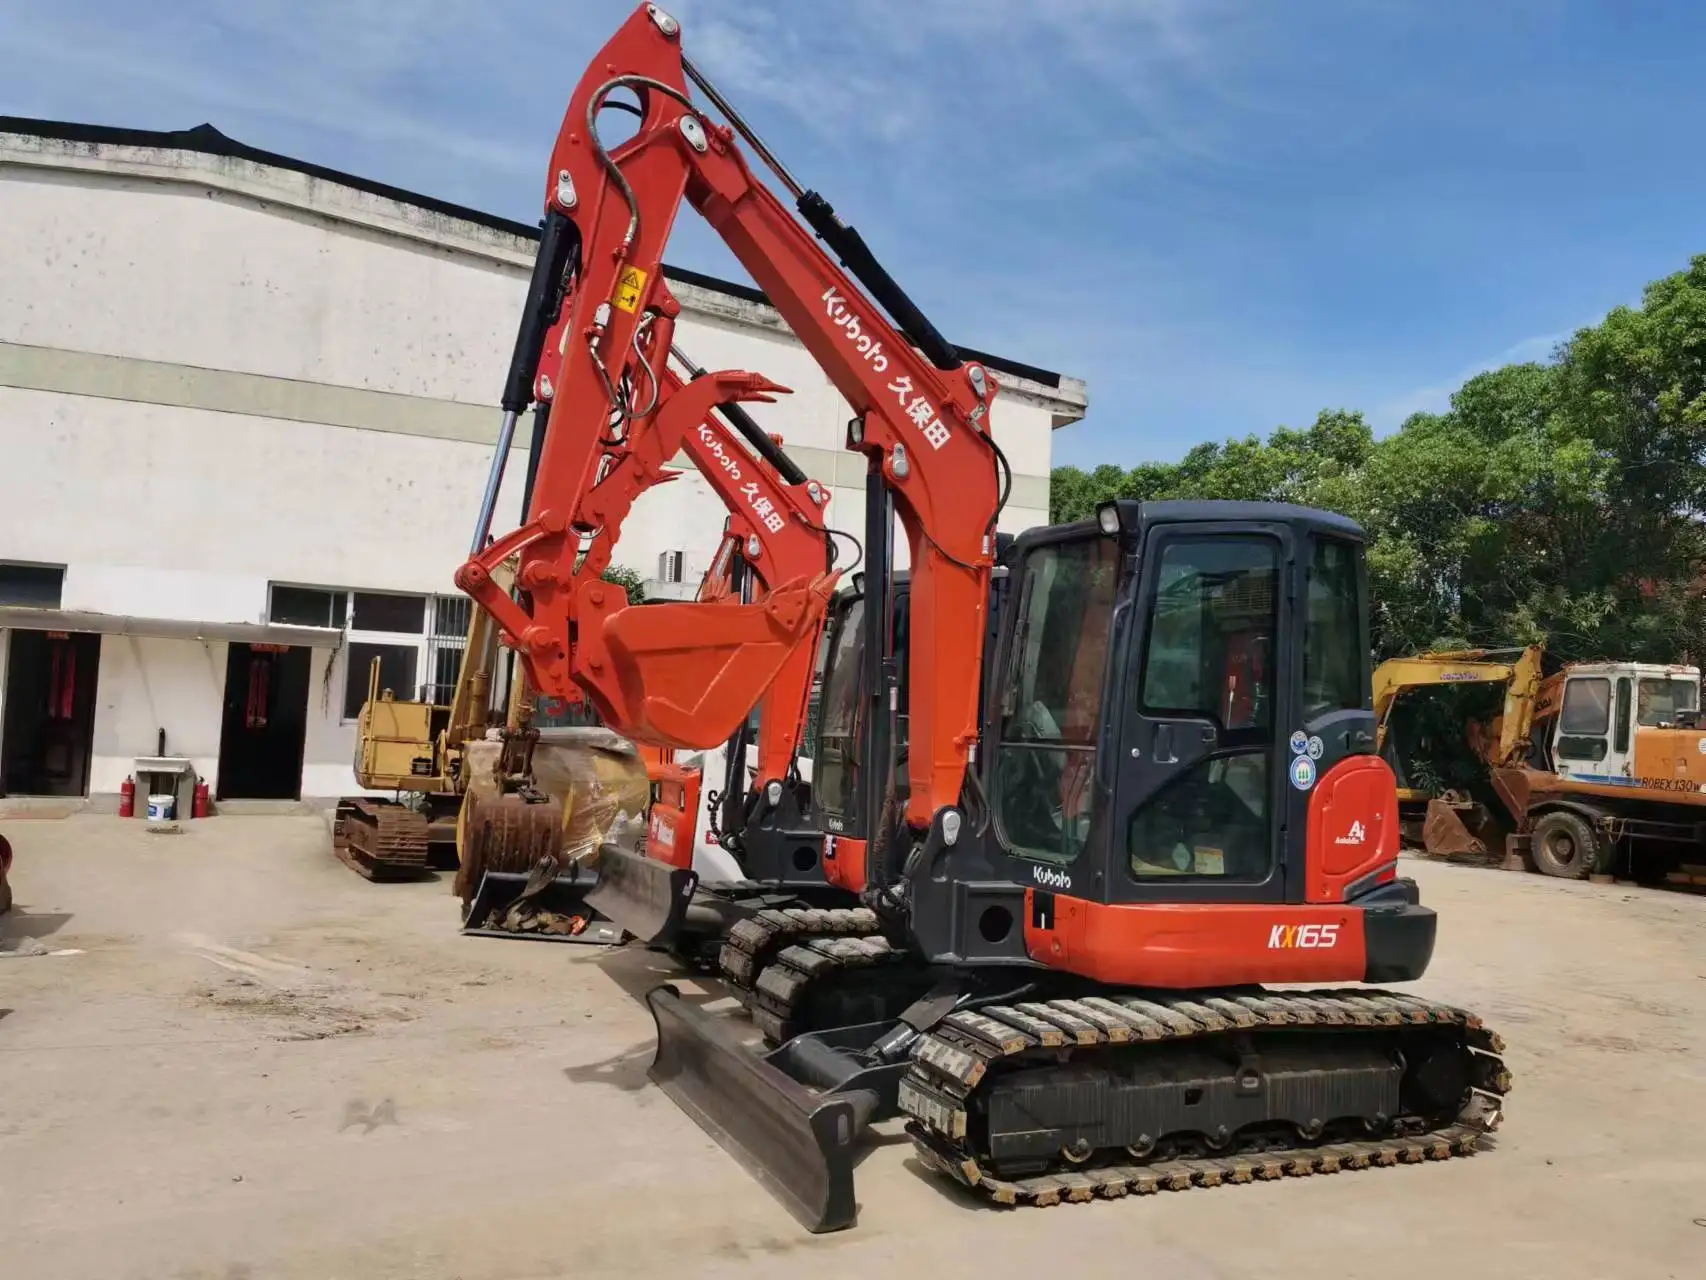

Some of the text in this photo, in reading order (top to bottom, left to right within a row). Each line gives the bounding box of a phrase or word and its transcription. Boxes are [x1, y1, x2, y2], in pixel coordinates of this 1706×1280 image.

[822, 286, 951, 451] Kubota 久保田
[697, 423, 785, 534] Kubota 久保田
[1641, 776, 1673, 791] ROBEX
[1033, 865, 1072, 888] Kubota
[1267, 924, 1340, 949] KX165
